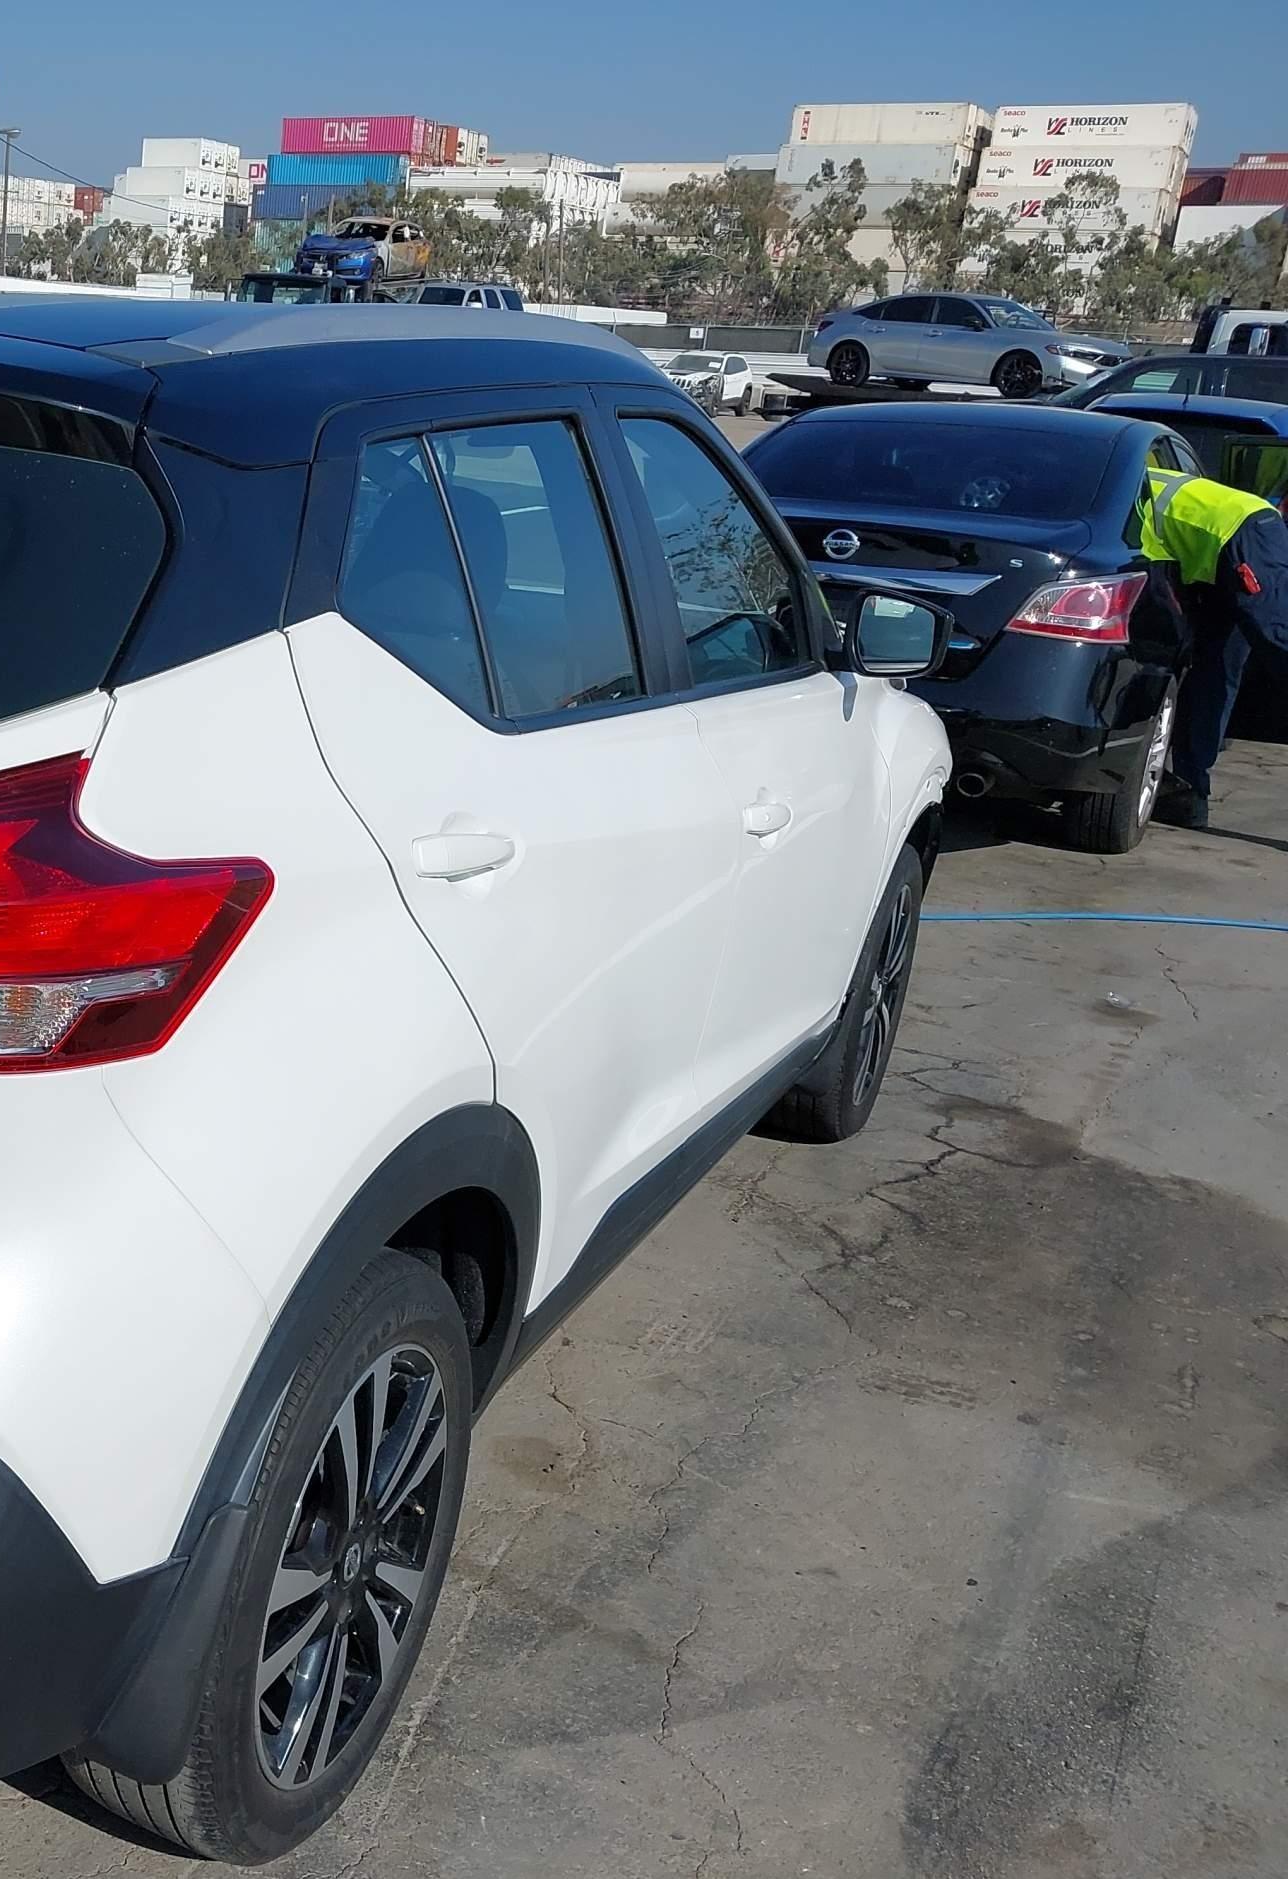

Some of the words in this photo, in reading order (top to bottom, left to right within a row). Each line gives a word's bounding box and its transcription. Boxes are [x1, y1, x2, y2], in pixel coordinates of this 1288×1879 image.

[1069, 116, 1128, 126] HORIZON
[323, 122, 369, 142] ONE
[1055, 158, 1114, 168] HORIZON
[248, 163, 268, 178] ON
[1009, 559, 1023, 568] S
